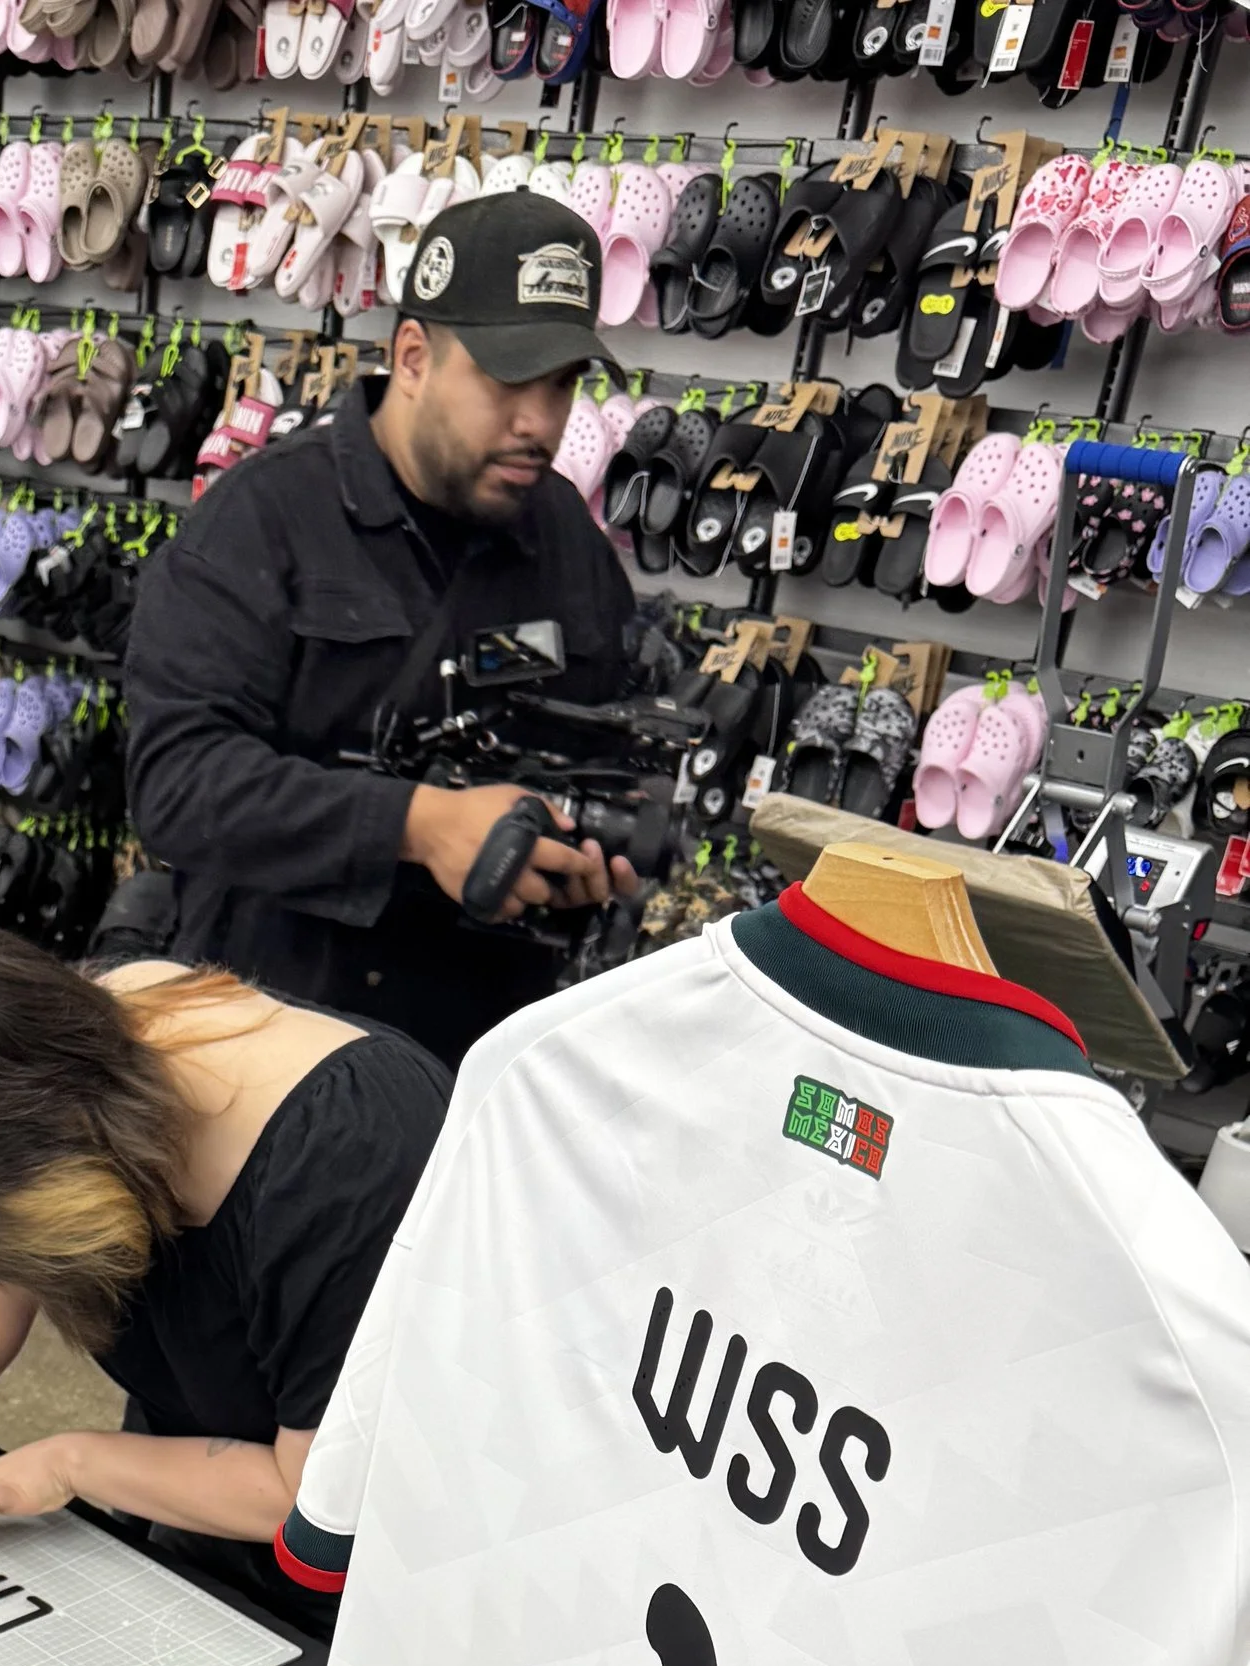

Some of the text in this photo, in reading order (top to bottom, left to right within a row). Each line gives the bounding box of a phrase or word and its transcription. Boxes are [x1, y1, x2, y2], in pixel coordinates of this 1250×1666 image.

[763, 408, 795, 422] NIKE
[891, 428, 925, 448] NIKE
[795, 1081, 890, 1146] SOMOS
[632, 1286, 892, 1576] WSS
